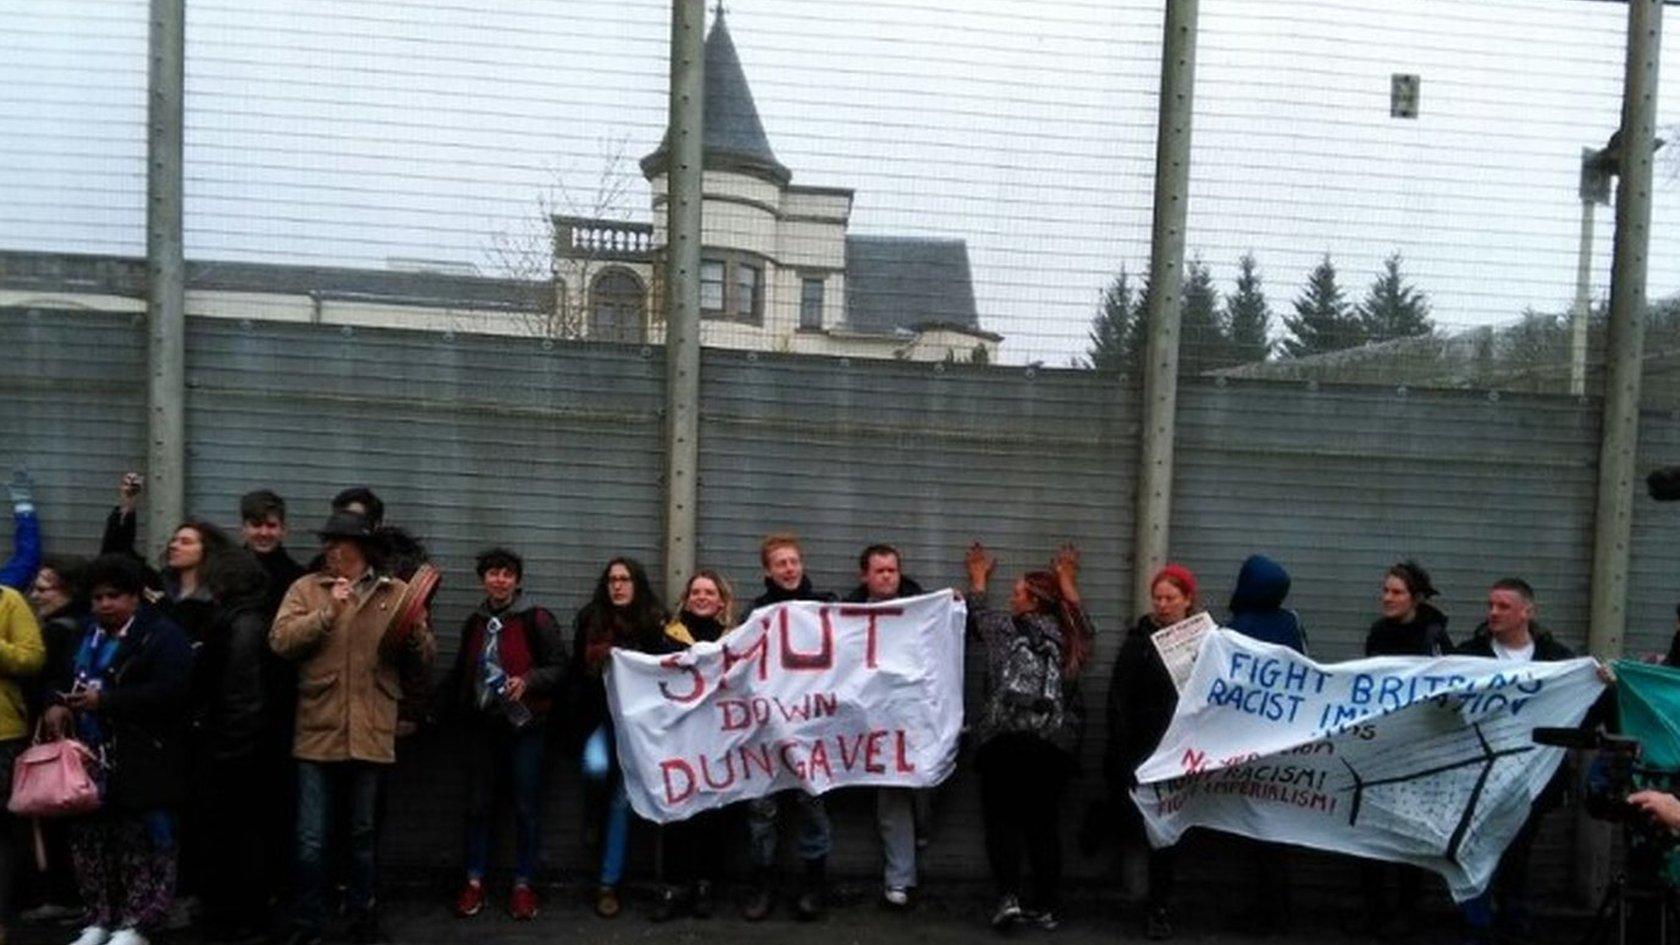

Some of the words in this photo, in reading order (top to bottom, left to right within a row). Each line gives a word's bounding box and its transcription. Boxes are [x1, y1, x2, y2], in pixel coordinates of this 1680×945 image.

[657, 606, 904, 702] SHUT
[1229, 652, 1334, 694] FIGHT
[716, 692, 838, 731] DOWN
[1206, 678, 1305, 723] RACIST
[659, 729, 916, 804] DUNGAVEL
